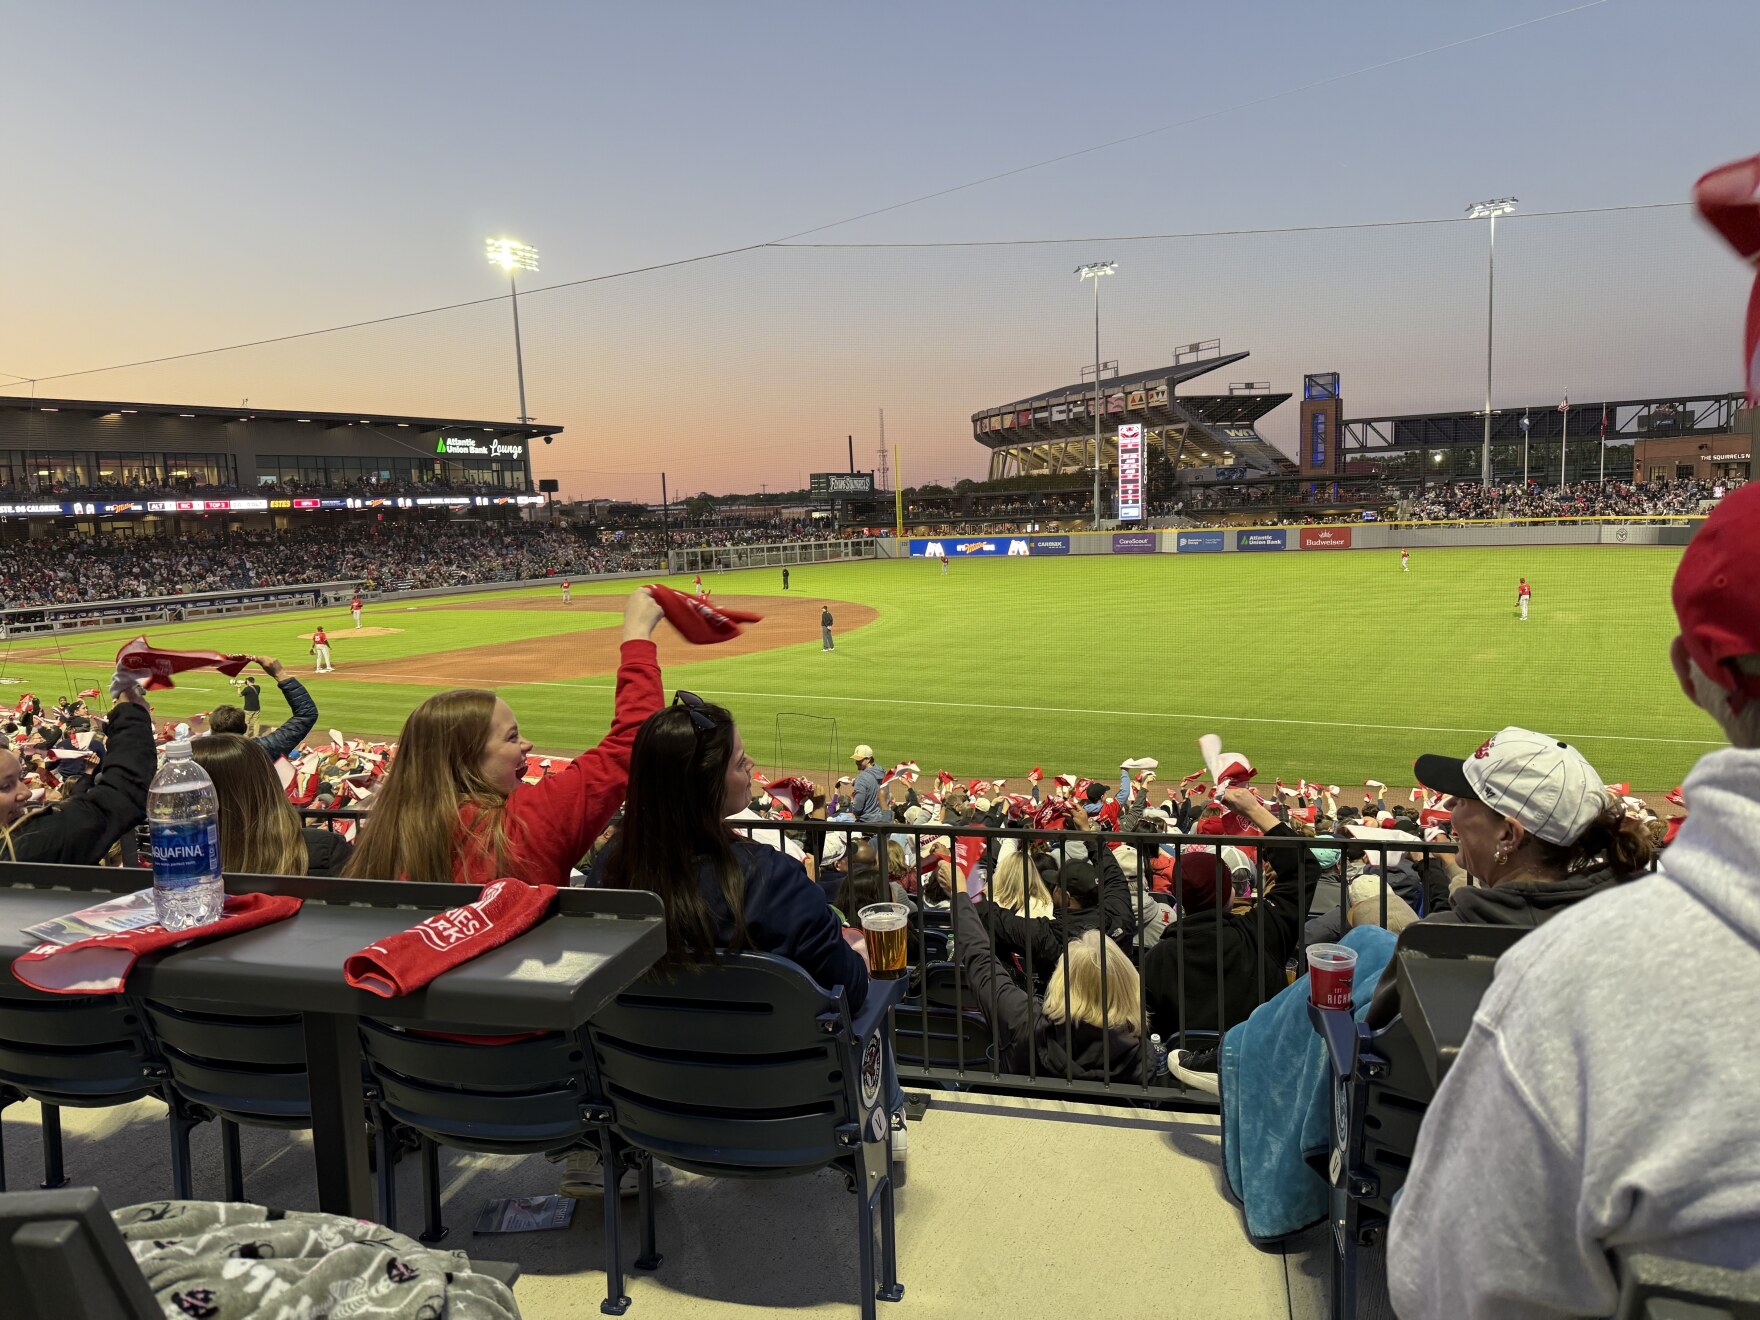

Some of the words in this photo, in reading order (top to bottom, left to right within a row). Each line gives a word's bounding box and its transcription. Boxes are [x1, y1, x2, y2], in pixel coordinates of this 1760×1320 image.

[446, 438, 475, 446] Atlantic
[469, 446, 488, 454] Bank
[489, 439, 523, 459] Lounge
[1306, 538, 1345, 546] Budweiser
